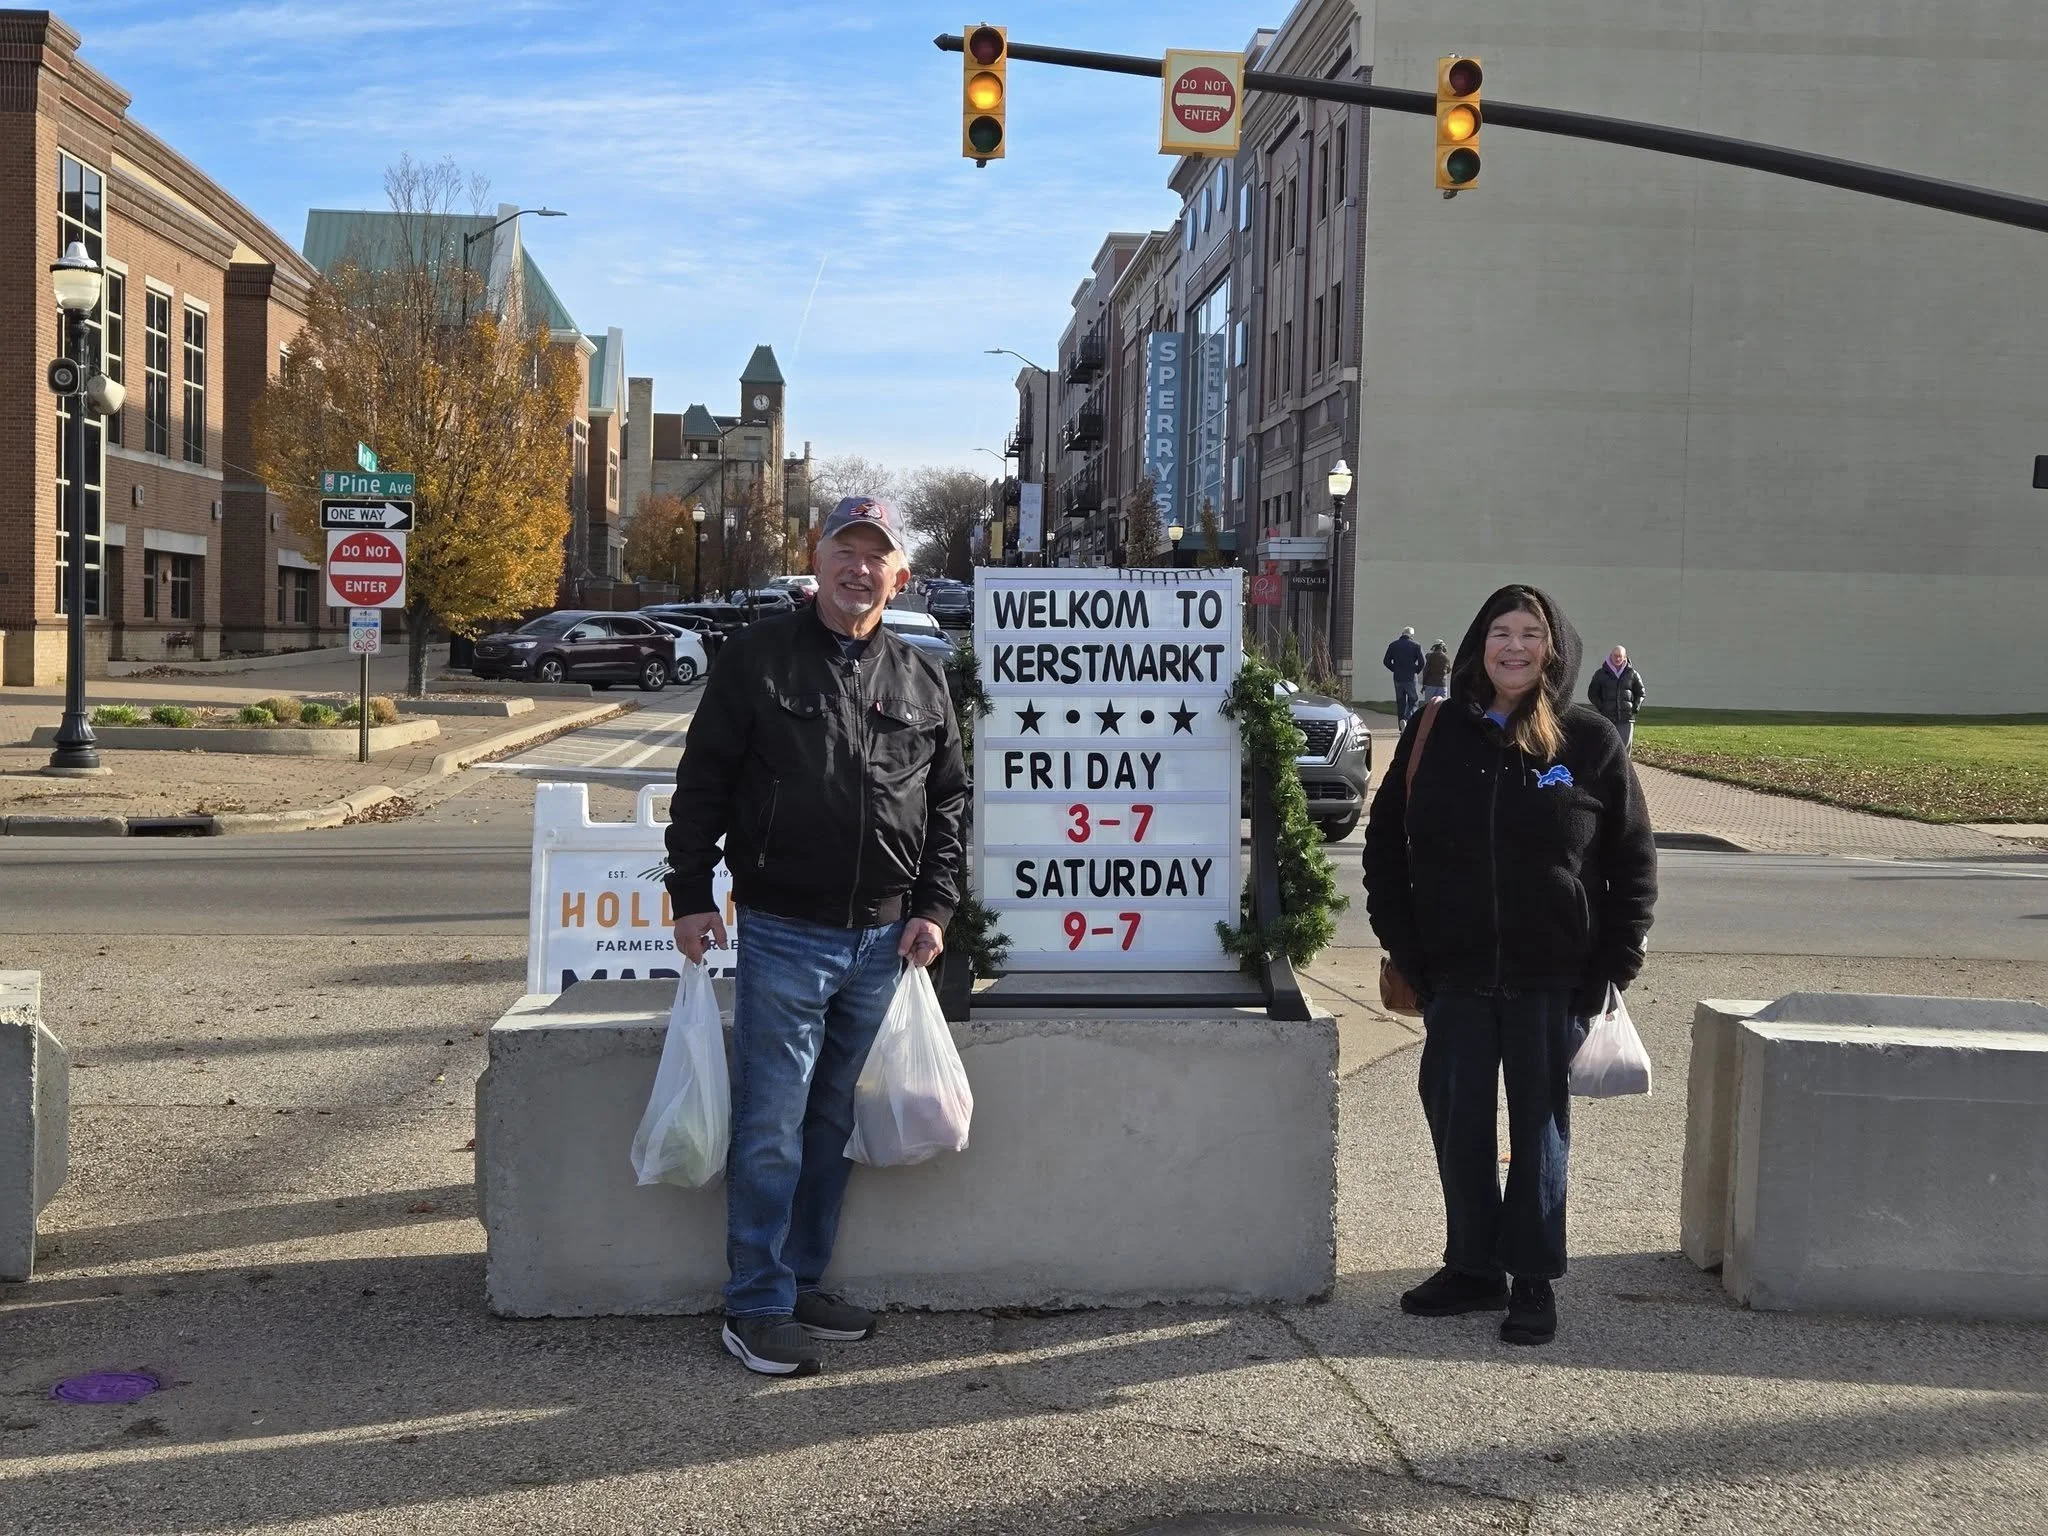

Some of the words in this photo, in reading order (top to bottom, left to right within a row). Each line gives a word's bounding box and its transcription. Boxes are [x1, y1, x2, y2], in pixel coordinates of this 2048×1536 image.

[1181, 79, 1197, 90] DO
[1204, 80, 1228, 92] NOT
[1184, 108, 1221, 121] ENTER
[1155, 341, 1177, 513] SPERRY'S
[339, 474, 381, 493] Pine
[388, 481, 412, 494] Ave
[330, 508, 355, 520] ONE
[360, 509, 386, 521] WAY
[342, 545, 360, 557] DO
[365, 545, 391, 558] NOT
[345, 580, 387, 593] ENTER
[993, 589, 1150, 629] WELKOM
[1176, 589, 1223, 629] TO
[993, 644, 1225, 684] KERSTMARKT
[1004, 751, 1161, 790] FRIDAY
[608, 870, 628, 879] EST.
[1015, 858, 1213, 899] SATURDAY
[596, 939, 675, 952] FARMERS
